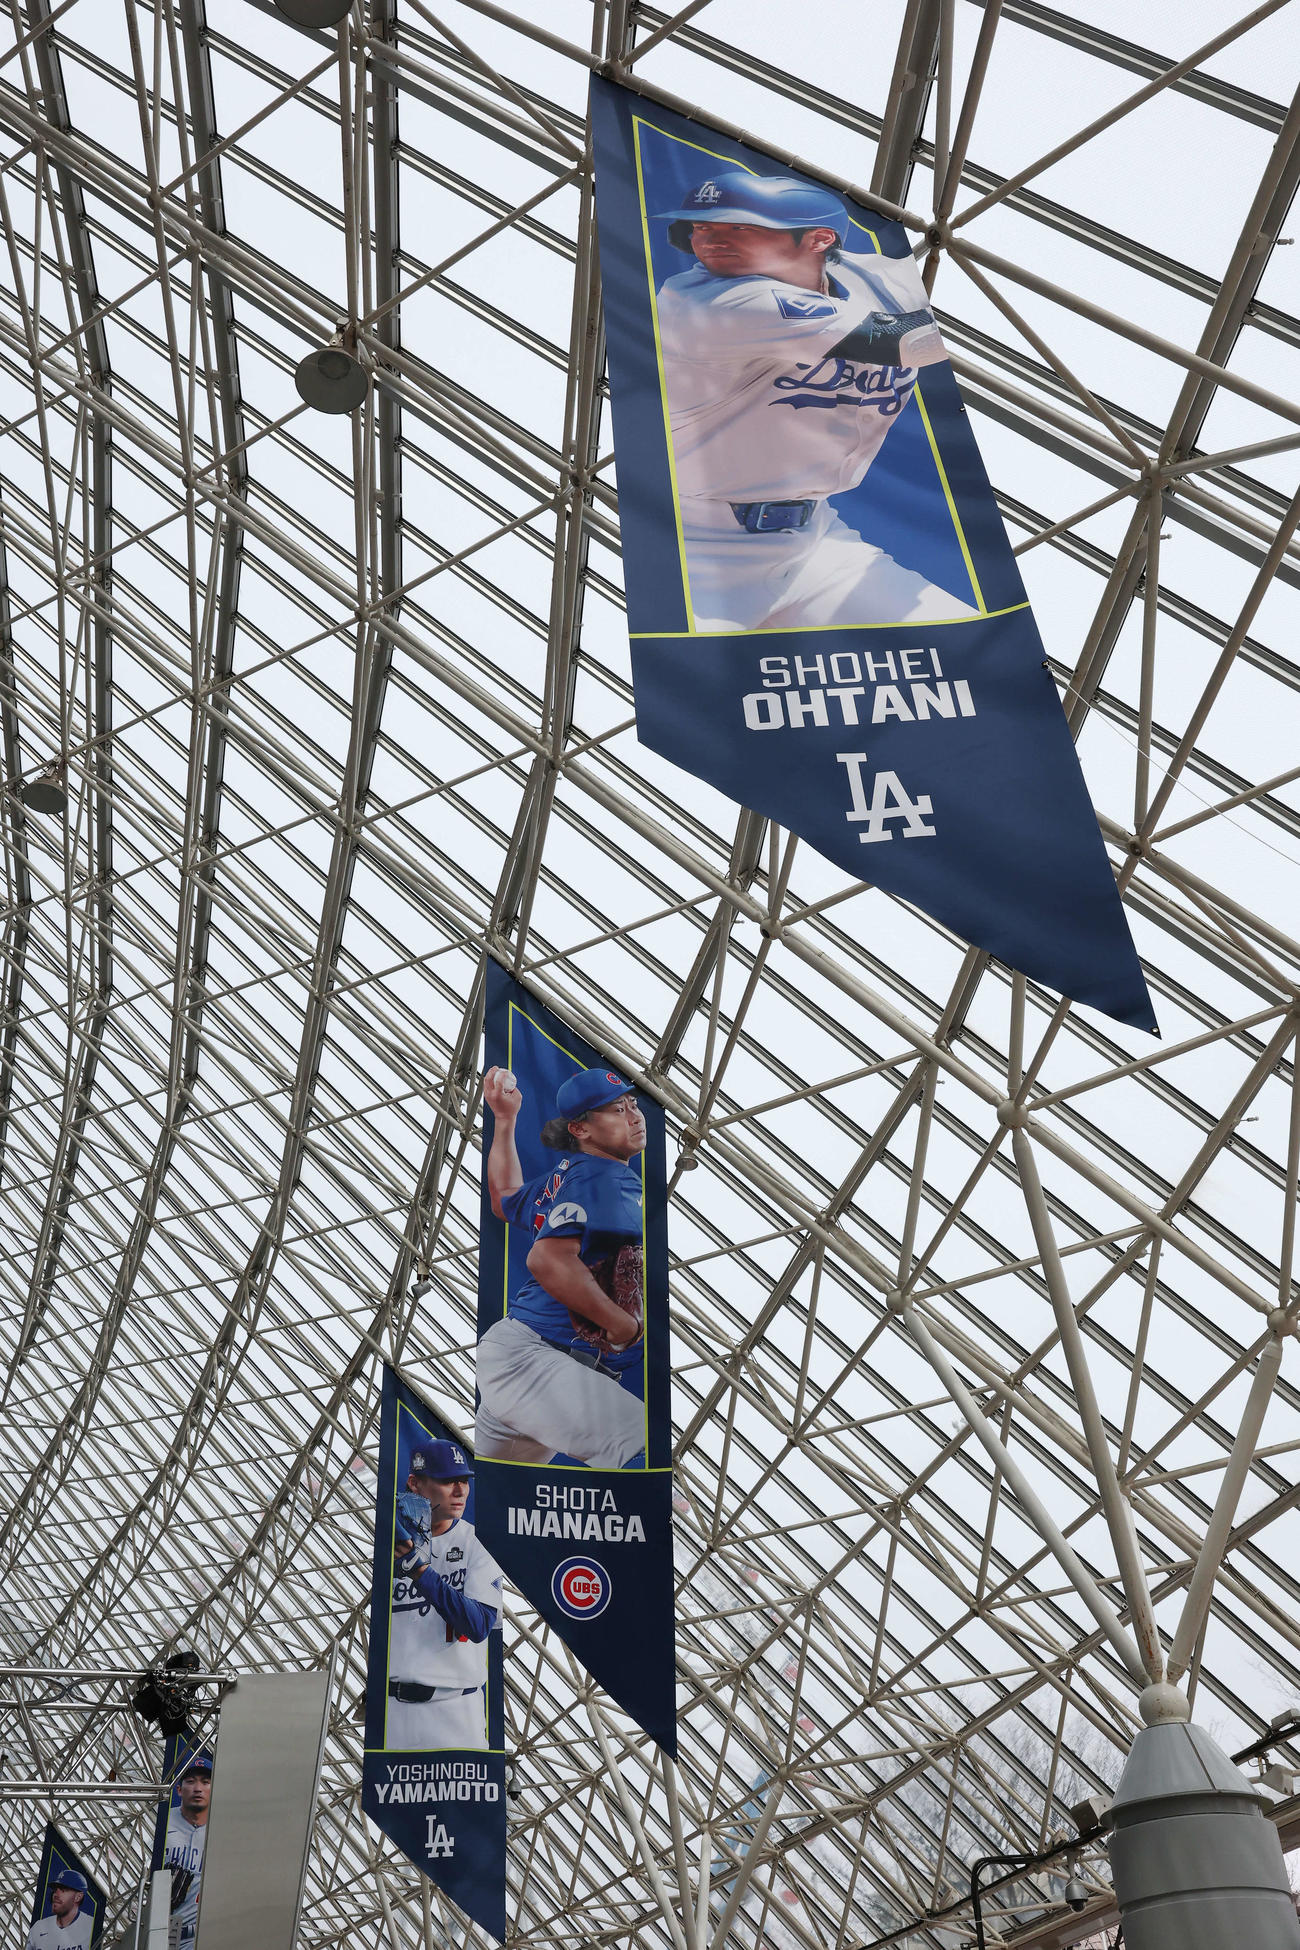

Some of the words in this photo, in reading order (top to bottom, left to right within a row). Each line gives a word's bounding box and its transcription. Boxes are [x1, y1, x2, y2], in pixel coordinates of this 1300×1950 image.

[694, 181, 721, 203] LA
[759, 648, 943, 687] SHOHEI
[742, 680, 977, 731] OHTANI
[836, 752, 937, 843] LA
[450, 1446, 465, 1464] LA
[536, 1484, 617, 1512] SHOTA
[508, 1507, 646, 1542] IMANAGA
[386, 1762, 488, 1782] YOSHINOBU
[375, 1781, 499, 1804] YAMAMOTO
[425, 1814, 455, 1859] LA
